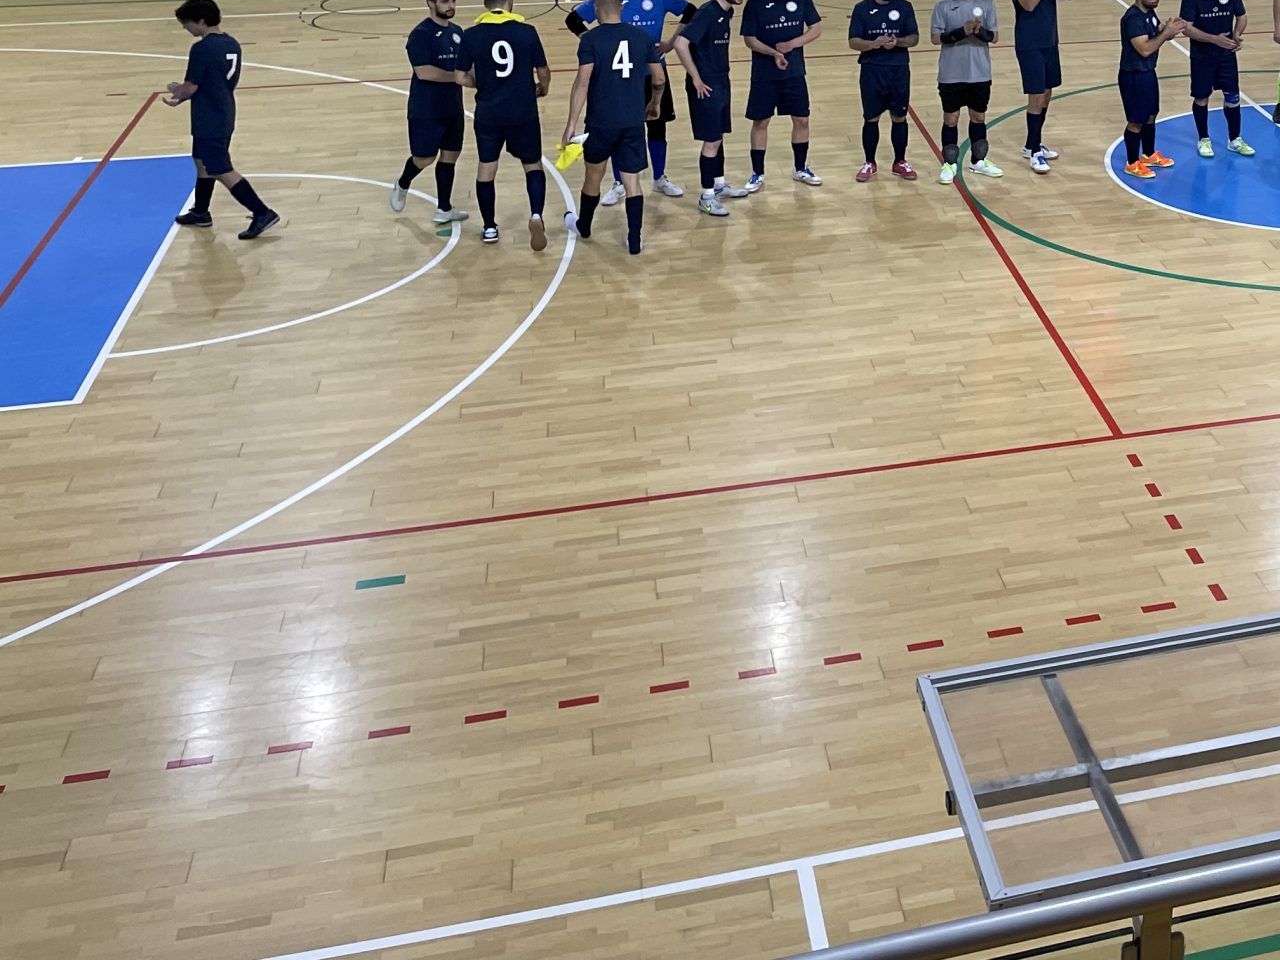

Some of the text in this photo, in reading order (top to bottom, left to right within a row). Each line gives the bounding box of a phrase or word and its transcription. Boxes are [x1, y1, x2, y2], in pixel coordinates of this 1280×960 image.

[226, 53, 238, 80] 7
[491, 40, 515, 78] 9
[612, 40, 634, 78] 4
